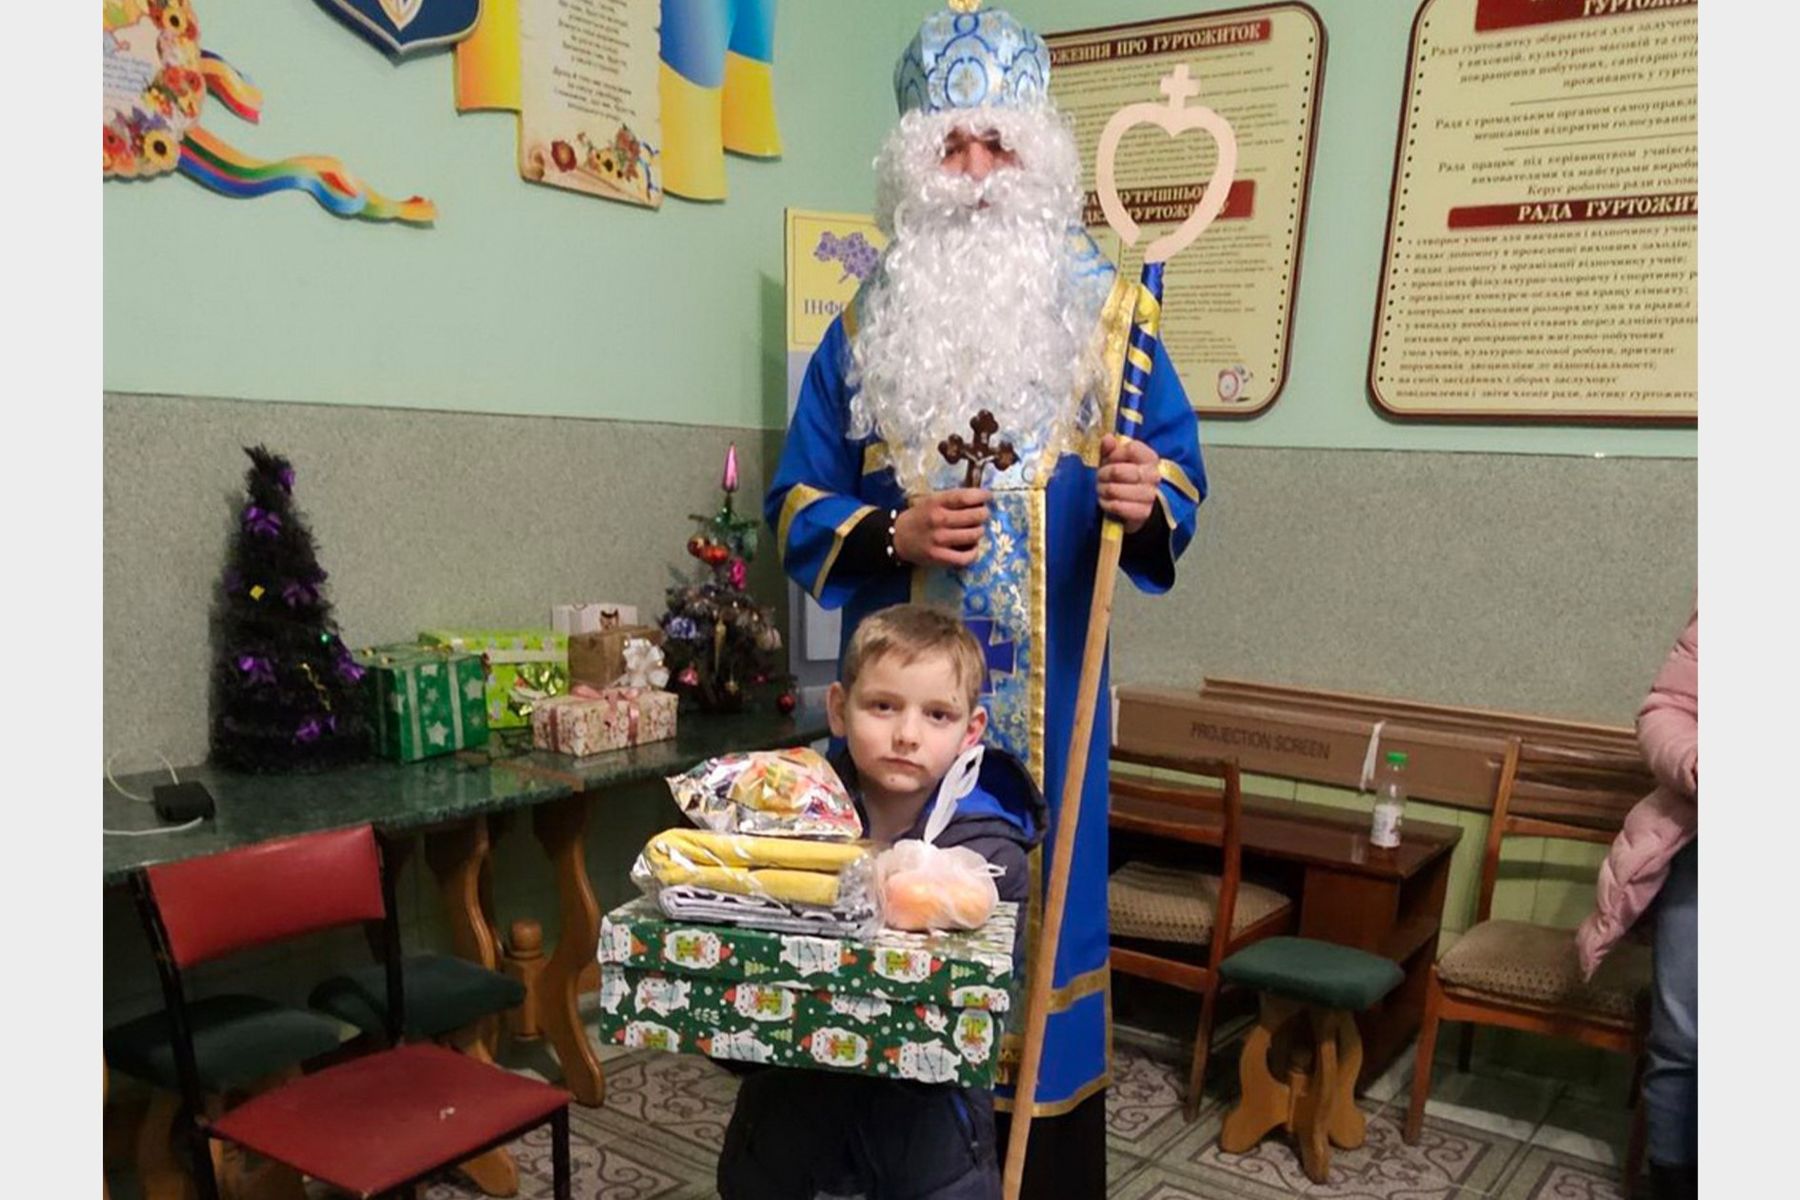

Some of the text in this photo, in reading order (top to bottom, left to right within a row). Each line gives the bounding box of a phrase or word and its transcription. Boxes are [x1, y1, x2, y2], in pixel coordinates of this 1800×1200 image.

[1117, 38, 1147, 57] ПРО
[1152, 23, 1261, 53] ГУРТОЖИТОК
[1517, 201, 1572, 221] РАДА
[1190, 721, 1331, 759] PROJECTION SCREEN
